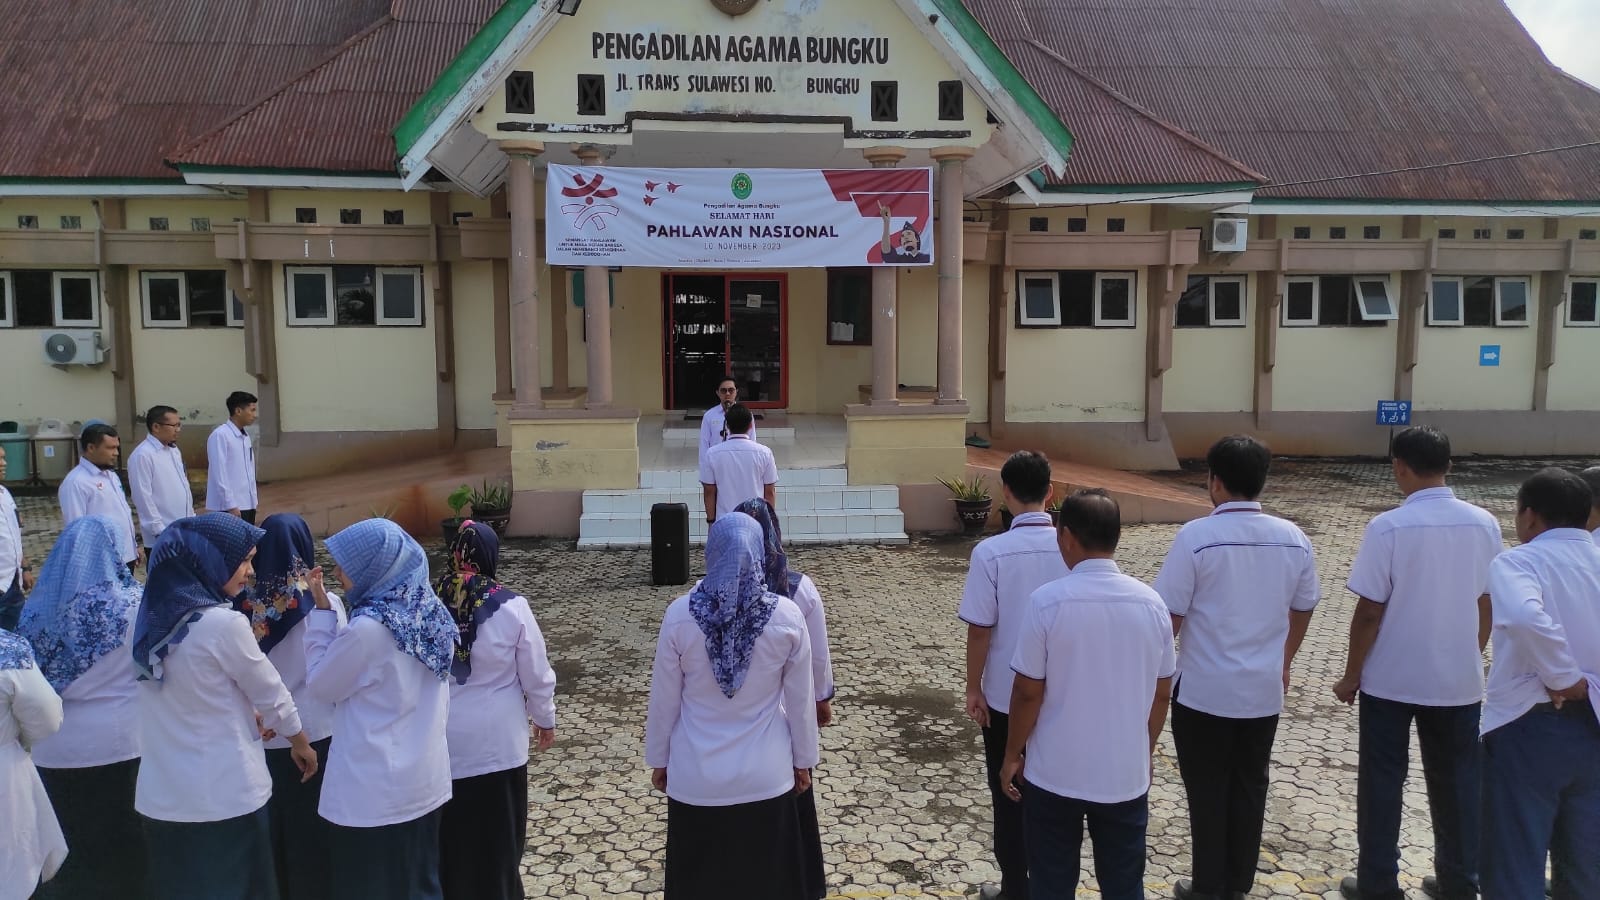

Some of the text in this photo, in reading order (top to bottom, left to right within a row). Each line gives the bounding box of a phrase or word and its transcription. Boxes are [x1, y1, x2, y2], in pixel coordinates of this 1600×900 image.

[592, 32, 889, 64] PENGADILAN AGAMA BUNGKU
[616, 73, 860, 94] JL. TRANS SULAWESI NO. BUNGKU
[710, 212, 775, 220] SELAMAT HARI
[647, 225, 839, 238] PAHLAWAN NASIONAL
[718, 242, 758, 250] NOVEMBER
[762, 242, 782, 250] 2023
